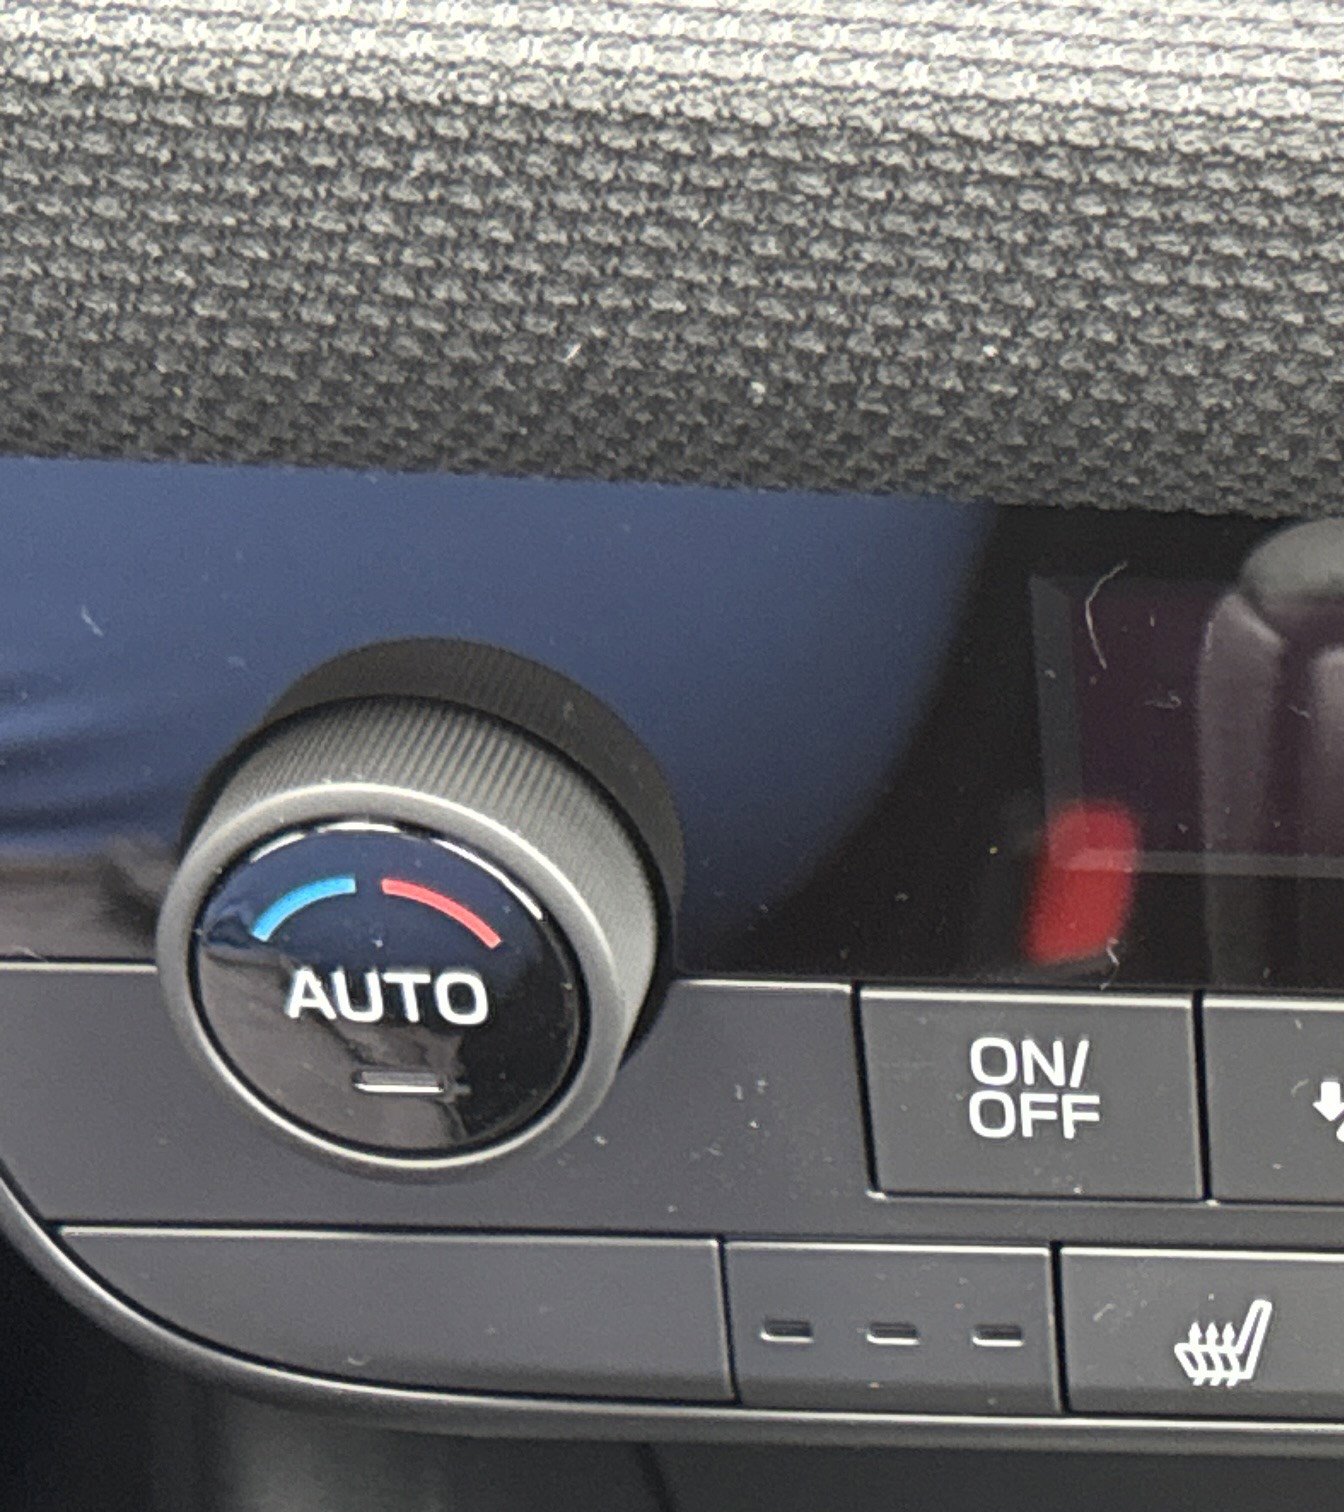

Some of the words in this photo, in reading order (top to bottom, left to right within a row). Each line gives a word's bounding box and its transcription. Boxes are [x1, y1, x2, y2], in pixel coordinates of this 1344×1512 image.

[284, 966, 489, 1025] AUTO
[970, 1036, 1090, 1089] ON/
[969, 1089, 1100, 1140] OFF
